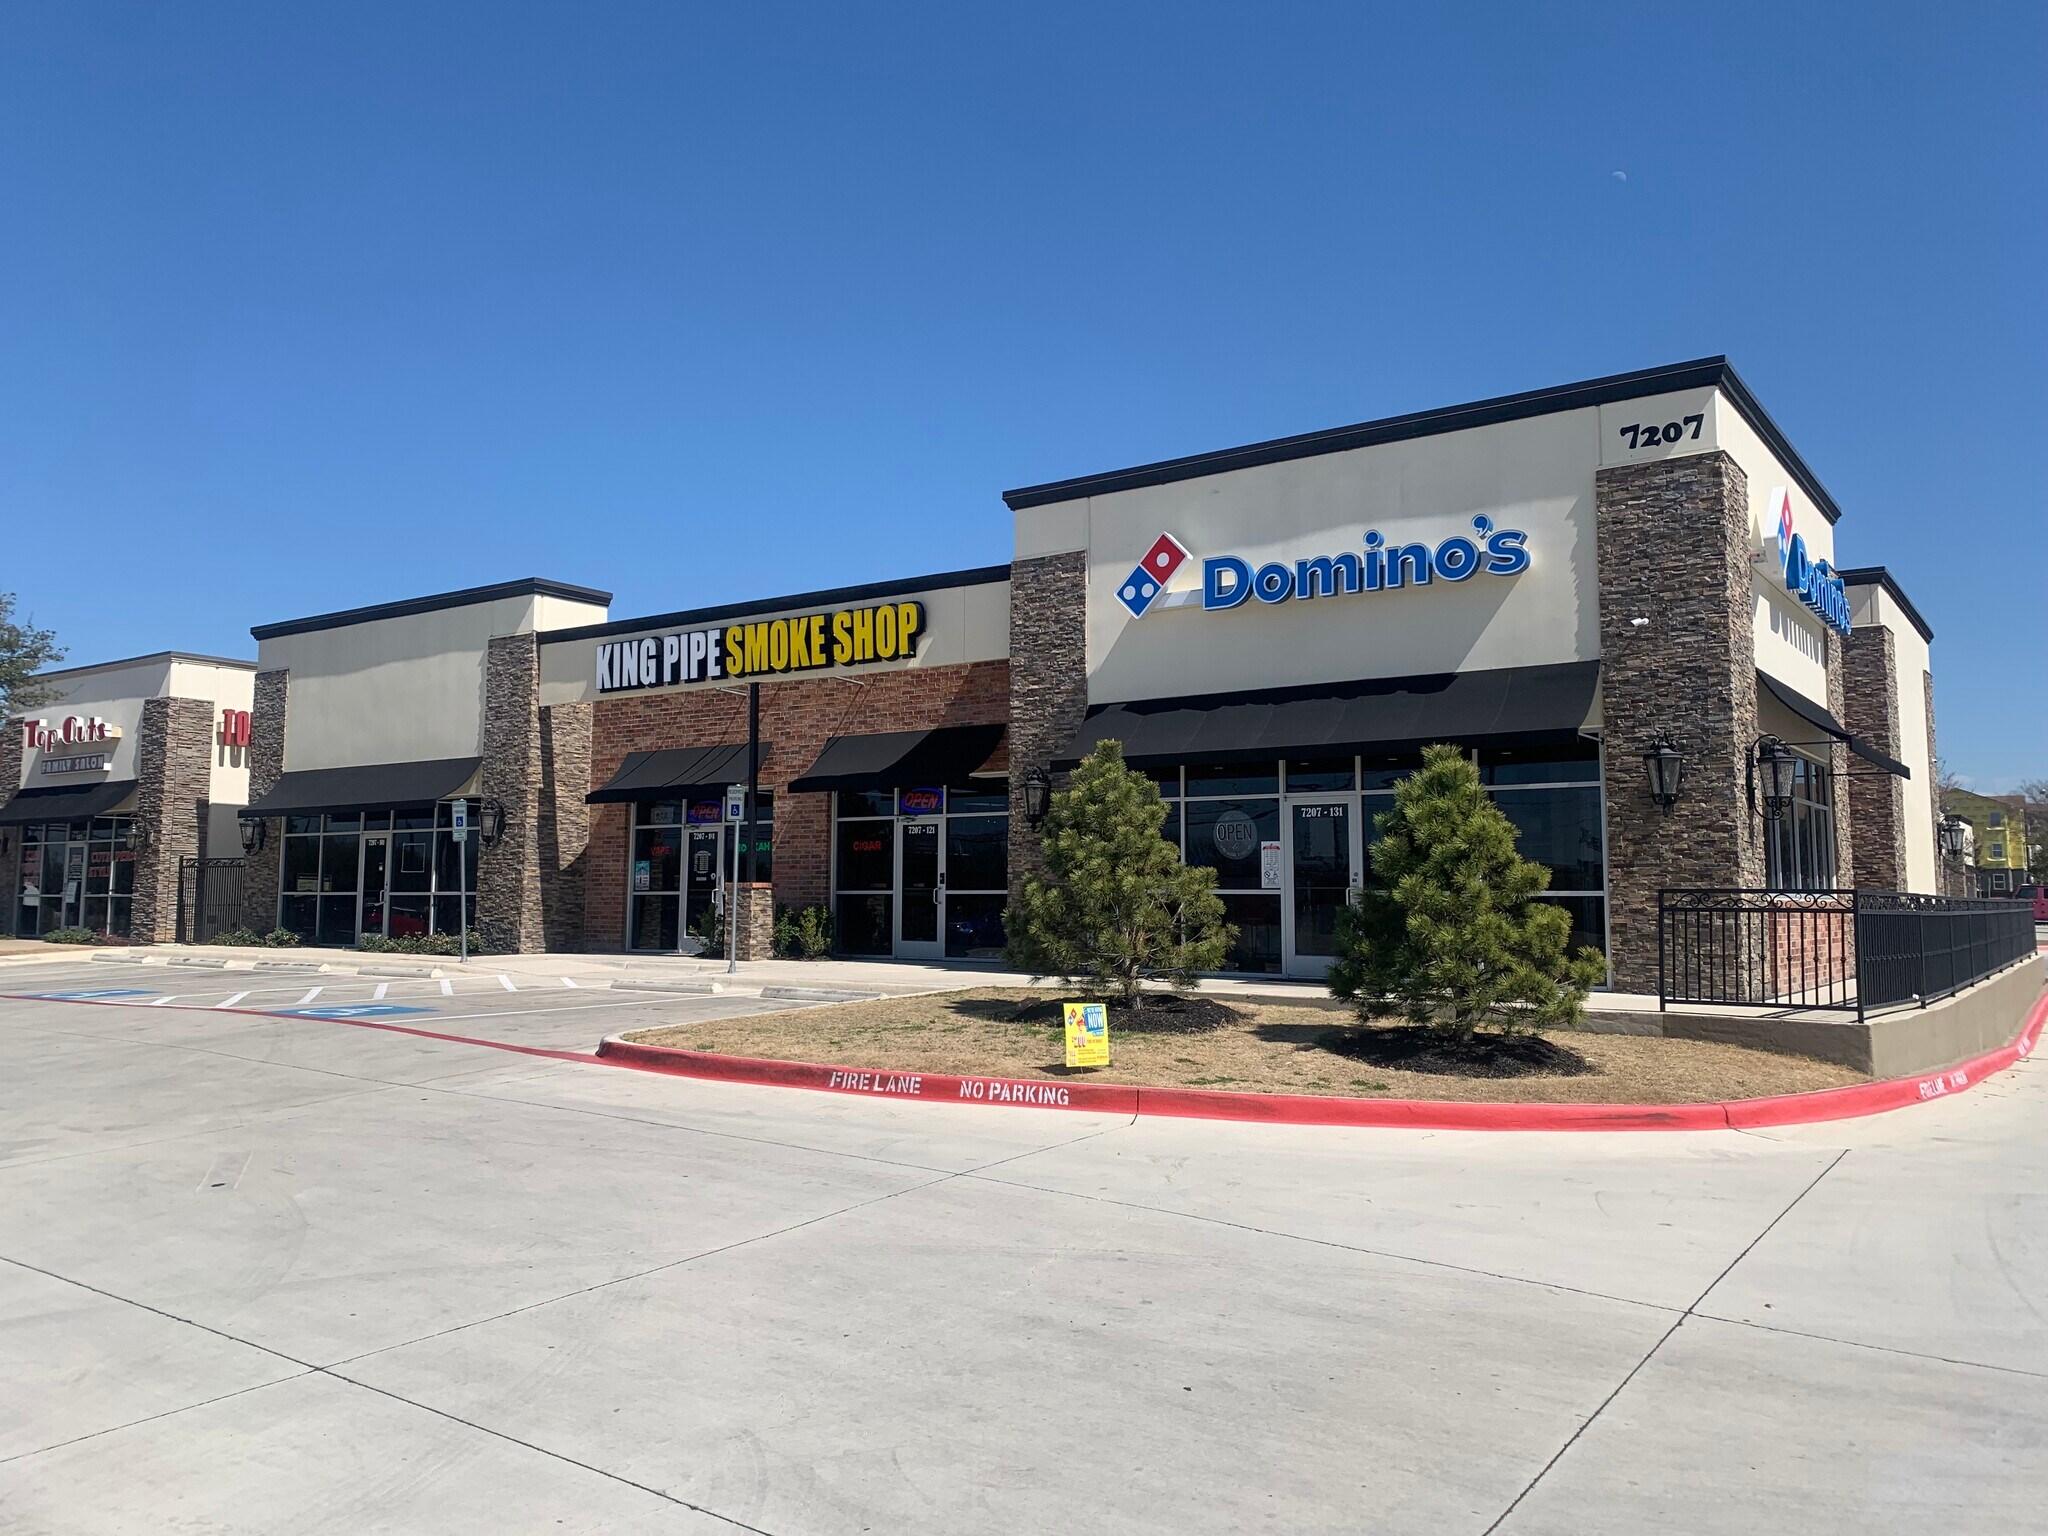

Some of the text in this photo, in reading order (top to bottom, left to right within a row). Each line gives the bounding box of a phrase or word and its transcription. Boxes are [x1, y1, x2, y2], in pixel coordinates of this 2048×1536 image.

[1619, 413, 1705, 450] 7207
[1201, 513, 1531, 612] Domino's
[595, 602, 921, 690] KING PIPE SMOKE SHOP
[24, 716, 107, 753] Top Cuts
[222, 708, 251, 747] TO
[41, 756, 104, 774] FAMILY SALON
[904, 792, 939, 809] OPEN
[693, 804, 720, 819] OPEN
[1301, 807, 1322, 818] 7207
[1329, 806, 1343, 817] 131
[907, 826, 922, 835] 7207
[926, 826, 936, 834] 121
[1216, 823, 1252, 842] OPEN
[853, 841, 882, 851] CIGAR
[1088, 1013, 1104, 1029] NOW
[829, 1070, 922, 1095] FIRE LANE
[959, 1080, 1070, 1107] NO PARKING
